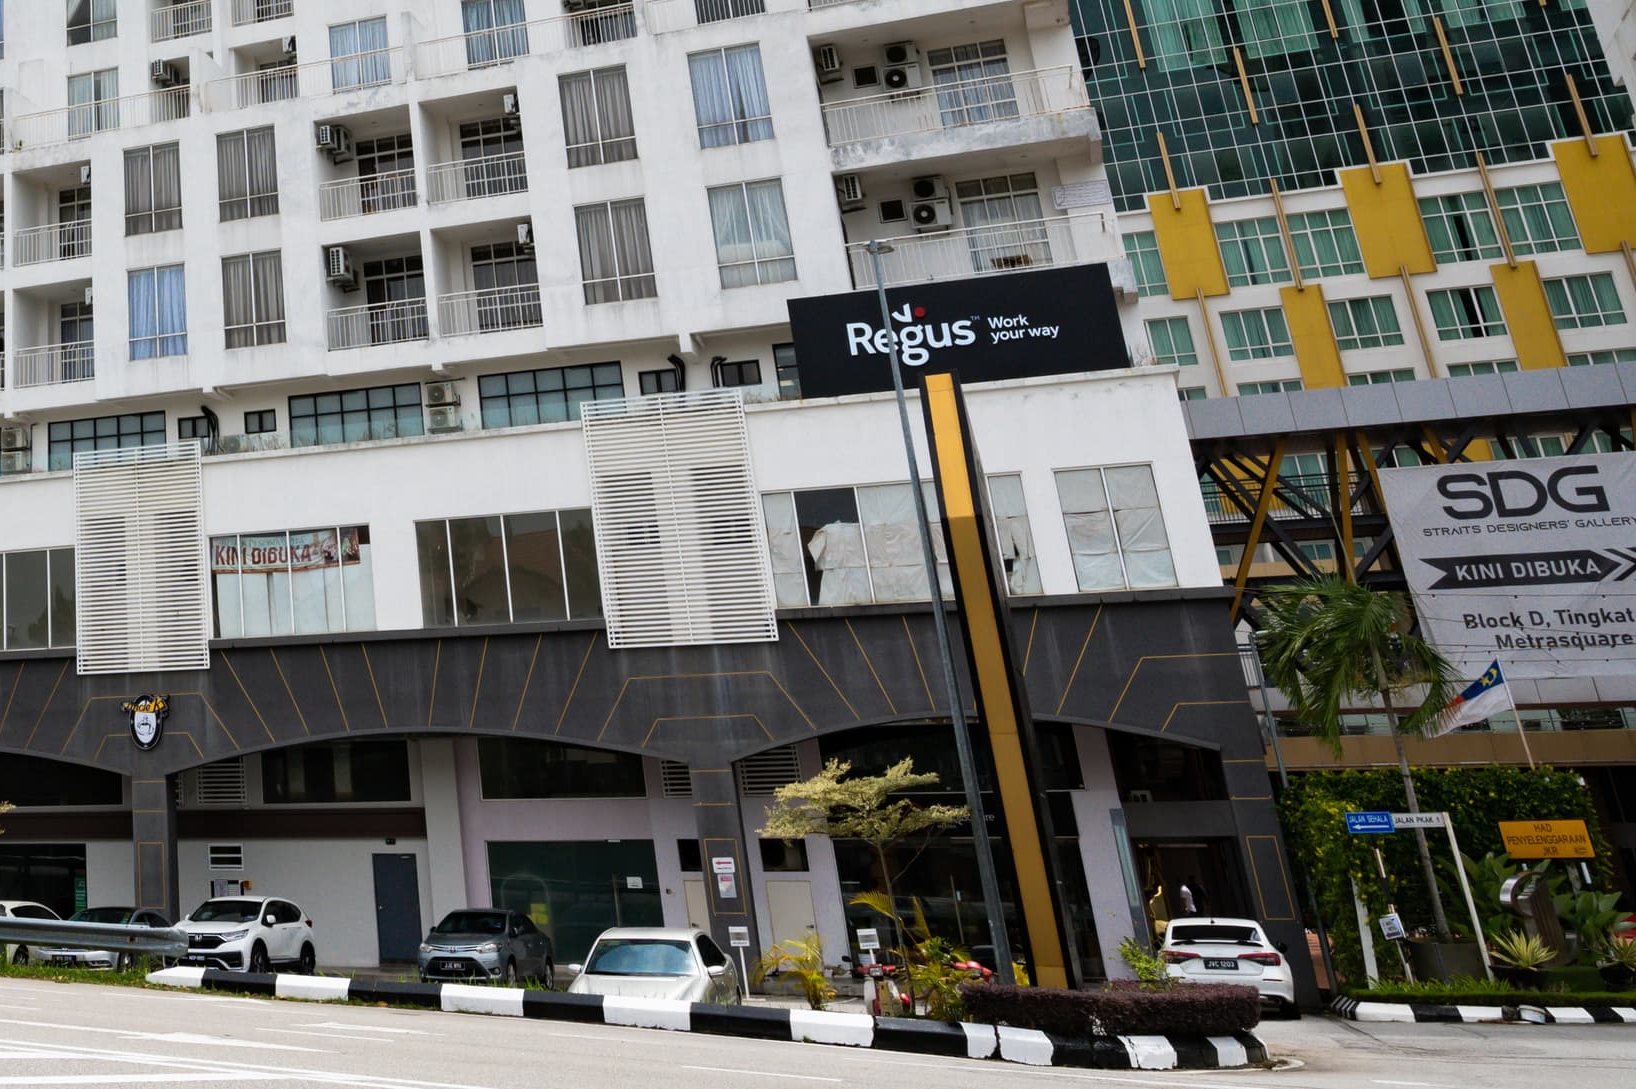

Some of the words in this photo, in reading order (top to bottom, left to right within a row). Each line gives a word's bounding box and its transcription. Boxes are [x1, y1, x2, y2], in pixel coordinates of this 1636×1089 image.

[988, 314, 1029, 330] Work
[846, 319, 976, 366] Regus
[990, 327, 1025, 344] your
[1028, 324, 1060, 339] way
[1437, 465, 1611, 520] SDG
[1423, 524, 1482, 537] STRAITS
[1487, 519, 1571, 533] DESIGNERS'
[1575, 515, 1636, 528] GALLERY
[1455, 564, 1505, 581] KINI
[1511, 557, 1602, 578] DIBUKA
[1463, 610, 1523, 629] Block
[1530, 609, 1551, 628] D,
[1553, 607, 1636, 628] Tingkat
[1494, 632, 1635, 651] Metrasquare
[1533, 823, 1552, 833] HAD
